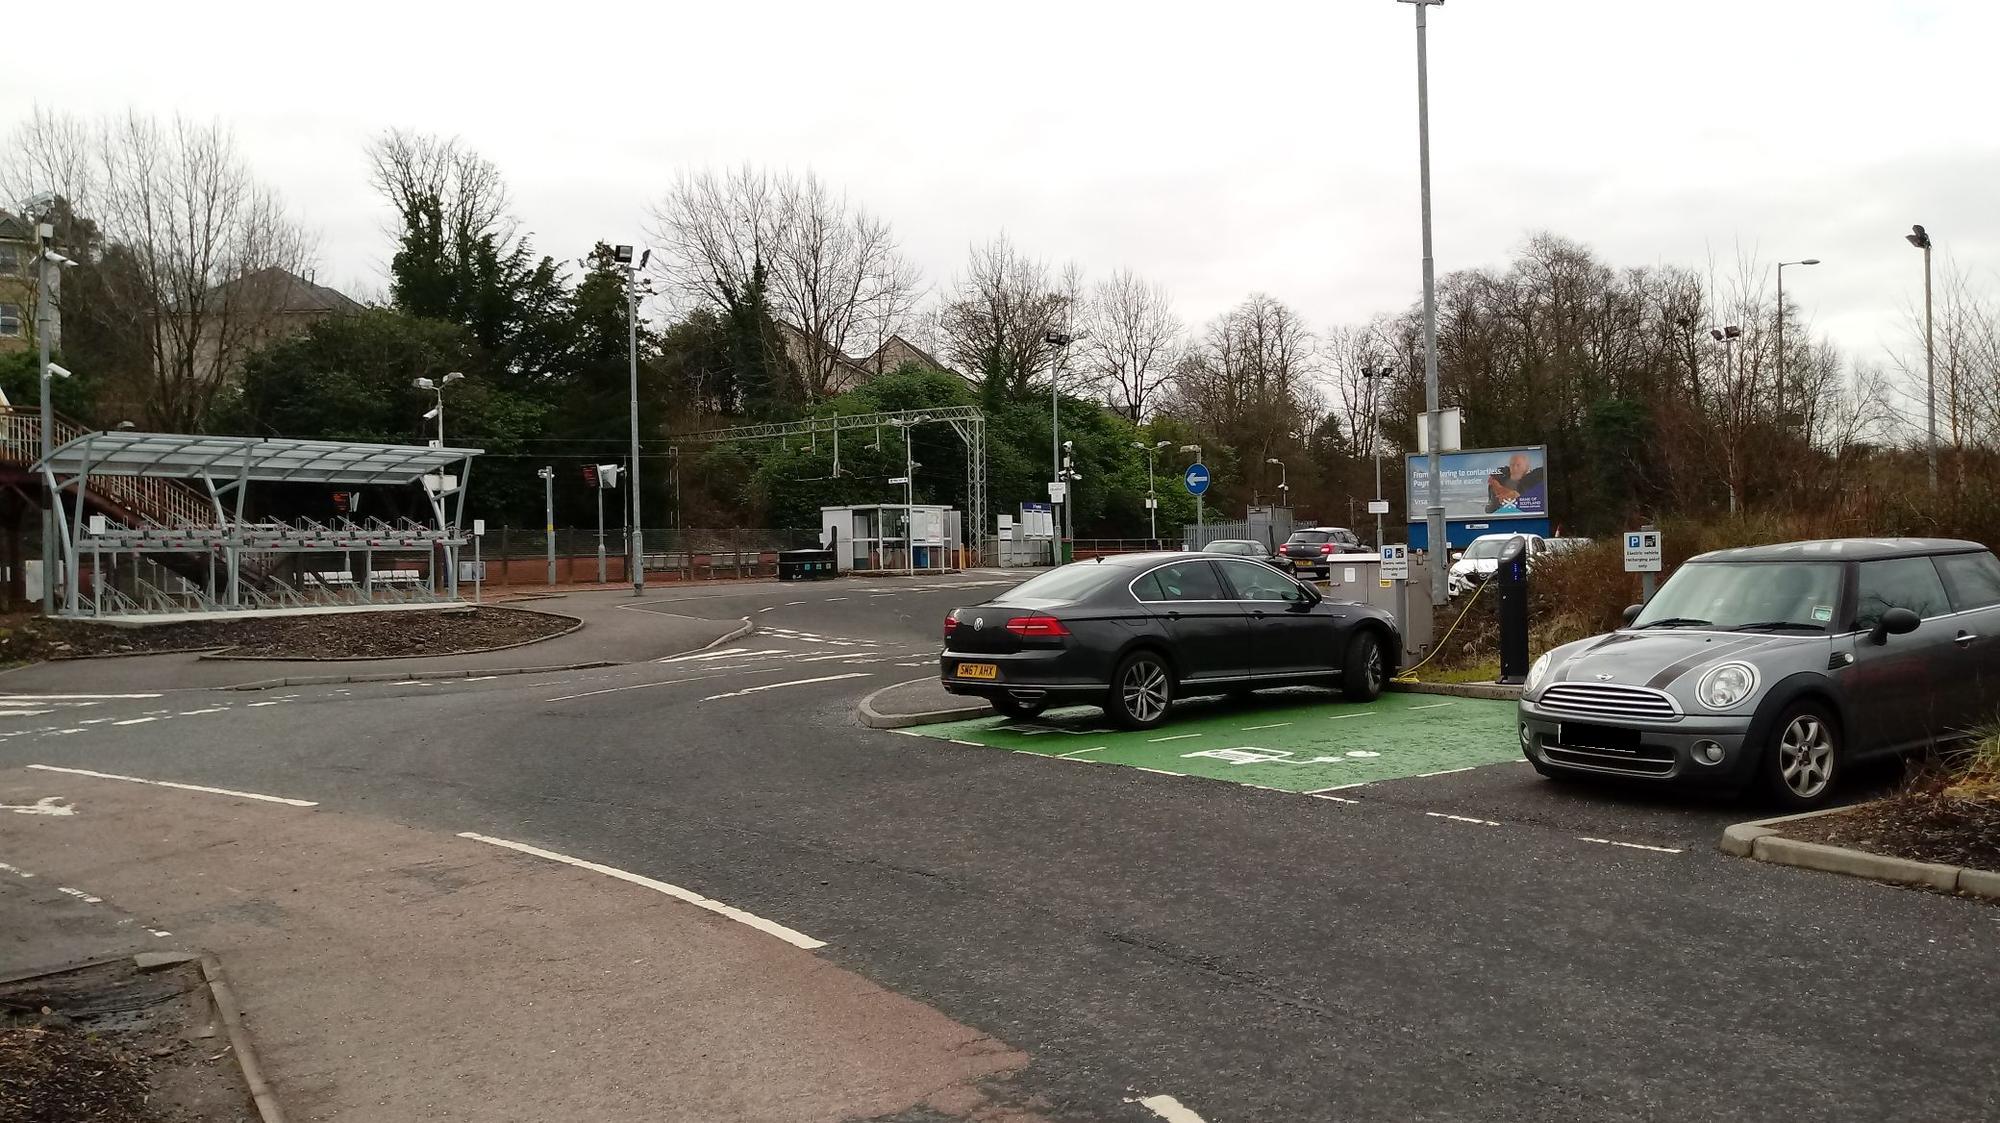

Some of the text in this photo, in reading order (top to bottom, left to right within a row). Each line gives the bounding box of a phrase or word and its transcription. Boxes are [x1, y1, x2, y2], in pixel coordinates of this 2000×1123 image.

[1413, 471, 1429, 479] From
[1458, 469, 1466, 477] to
[1631, 537, 1639, 547] P
[1386, 549, 1391, 558] P
